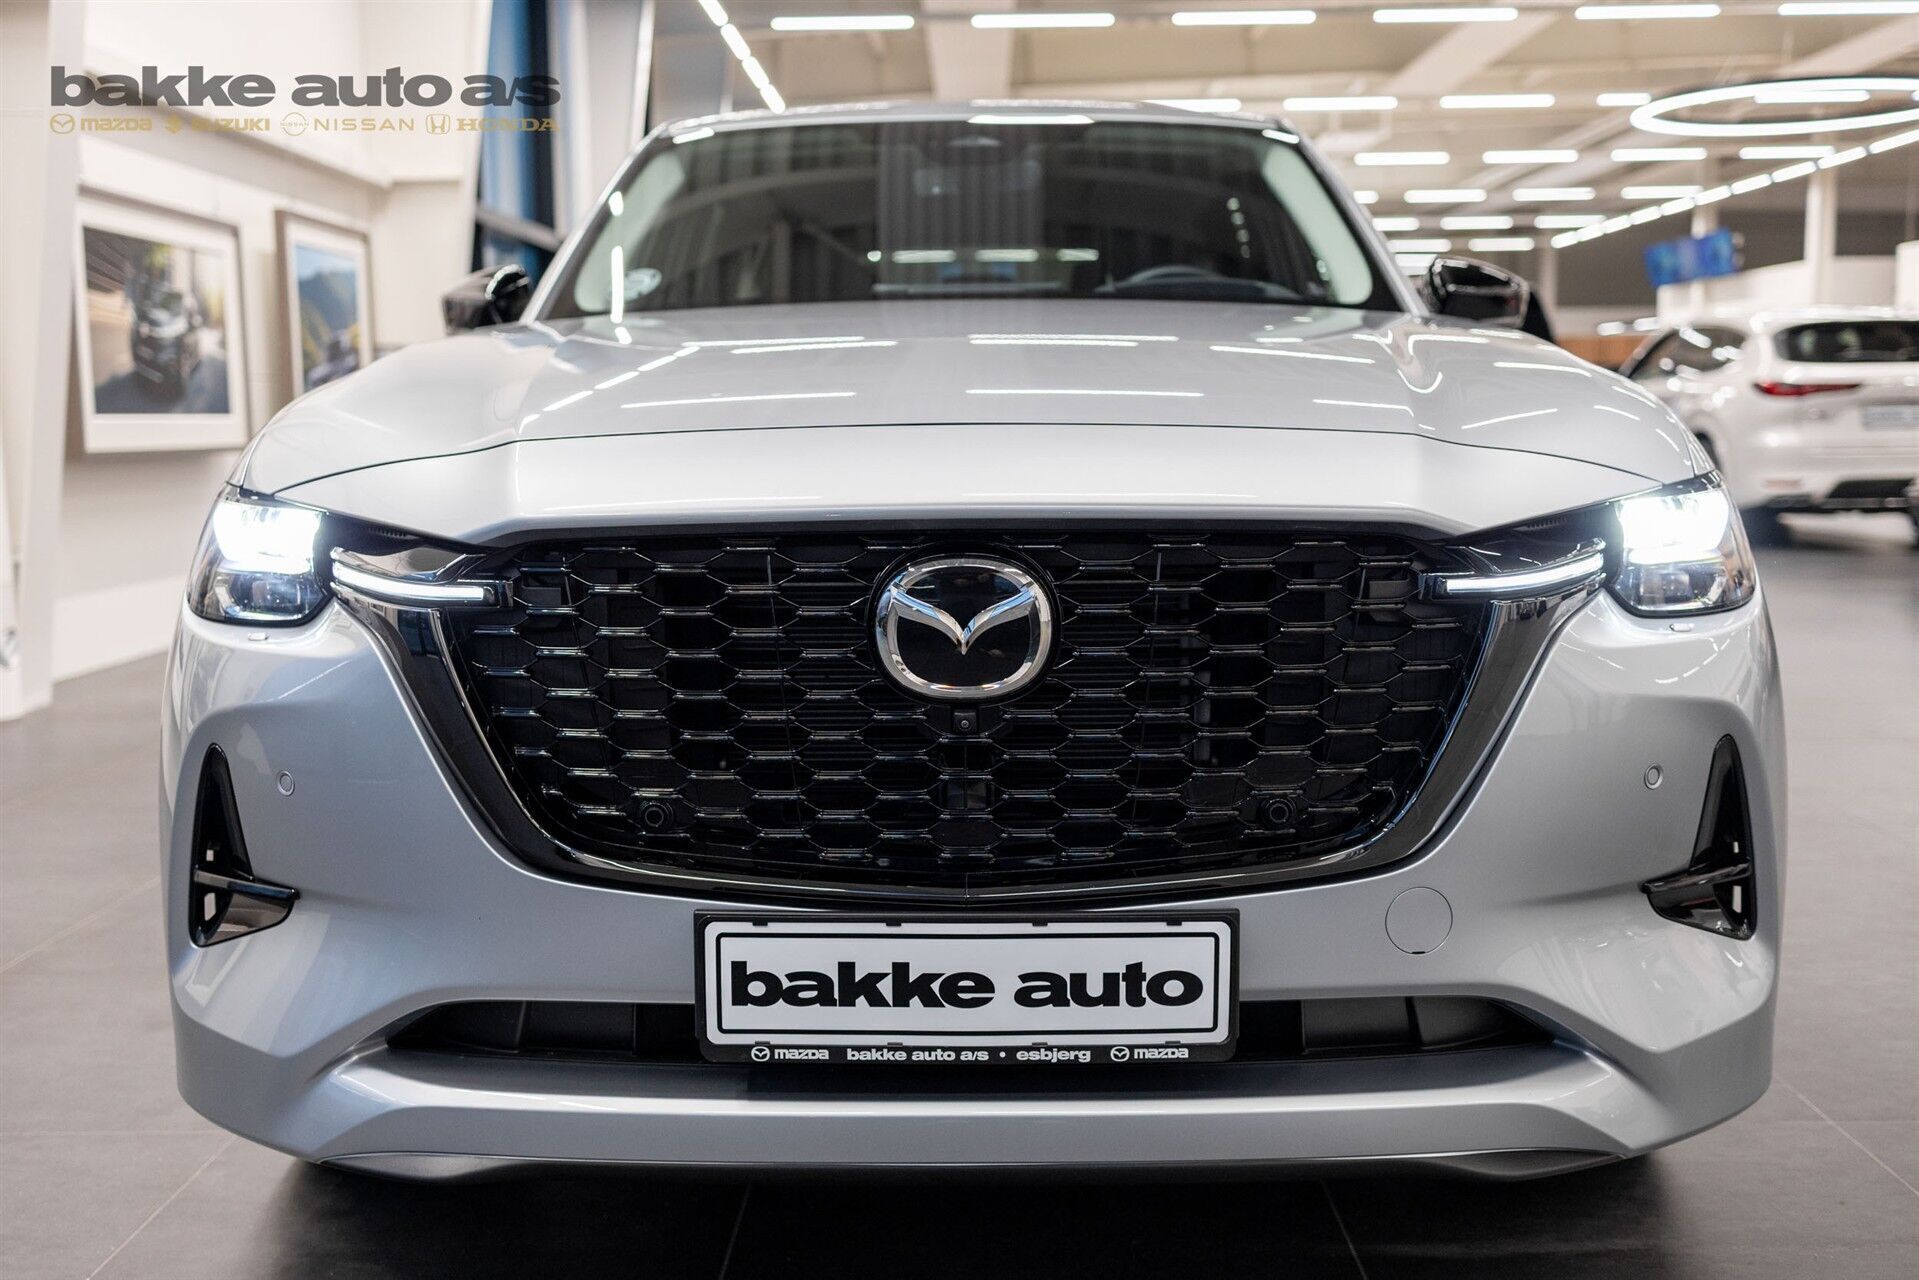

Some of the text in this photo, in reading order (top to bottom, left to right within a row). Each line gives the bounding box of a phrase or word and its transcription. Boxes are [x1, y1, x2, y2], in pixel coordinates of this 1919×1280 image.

[730, 960, 1204, 1009] bakke auto
[846, 1048, 908, 1061] bakke
[911, 1049, 956, 1061] auto
[960, 1050, 990, 1061] a/s
[1016, 1048, 1091, 1063] esbjerg
